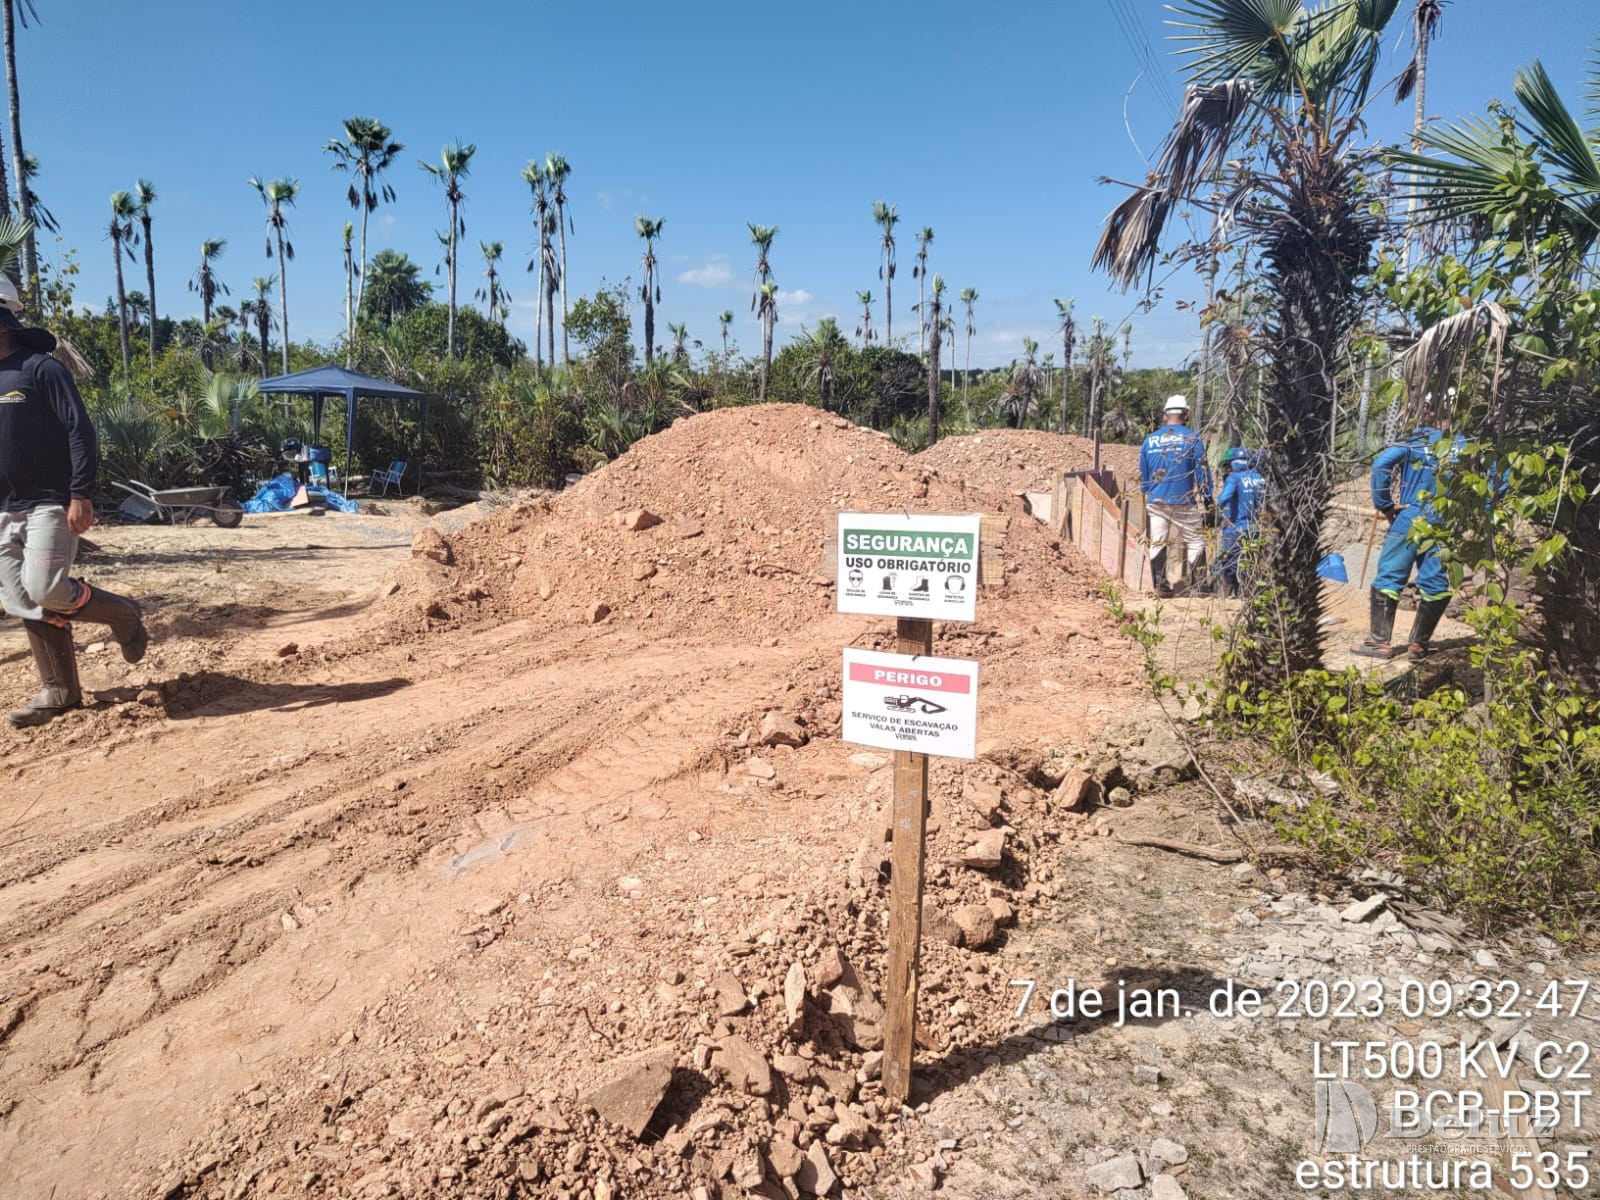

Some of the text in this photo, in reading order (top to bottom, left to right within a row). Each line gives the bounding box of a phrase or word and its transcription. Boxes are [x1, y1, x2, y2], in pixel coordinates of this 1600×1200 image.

[846, 534, 969, 557] SEGURANÇA
[845, 557, 971, 574] USO OBRIGATÓRIO
[874, 670, 942, 687] PERIGO
[851, 711, 958, 732] SERVIÇO DE ESCAVAÇÃO
[869, 722, 896, 733] VALAS
[899, 726, 940, 738] ABERTAS
